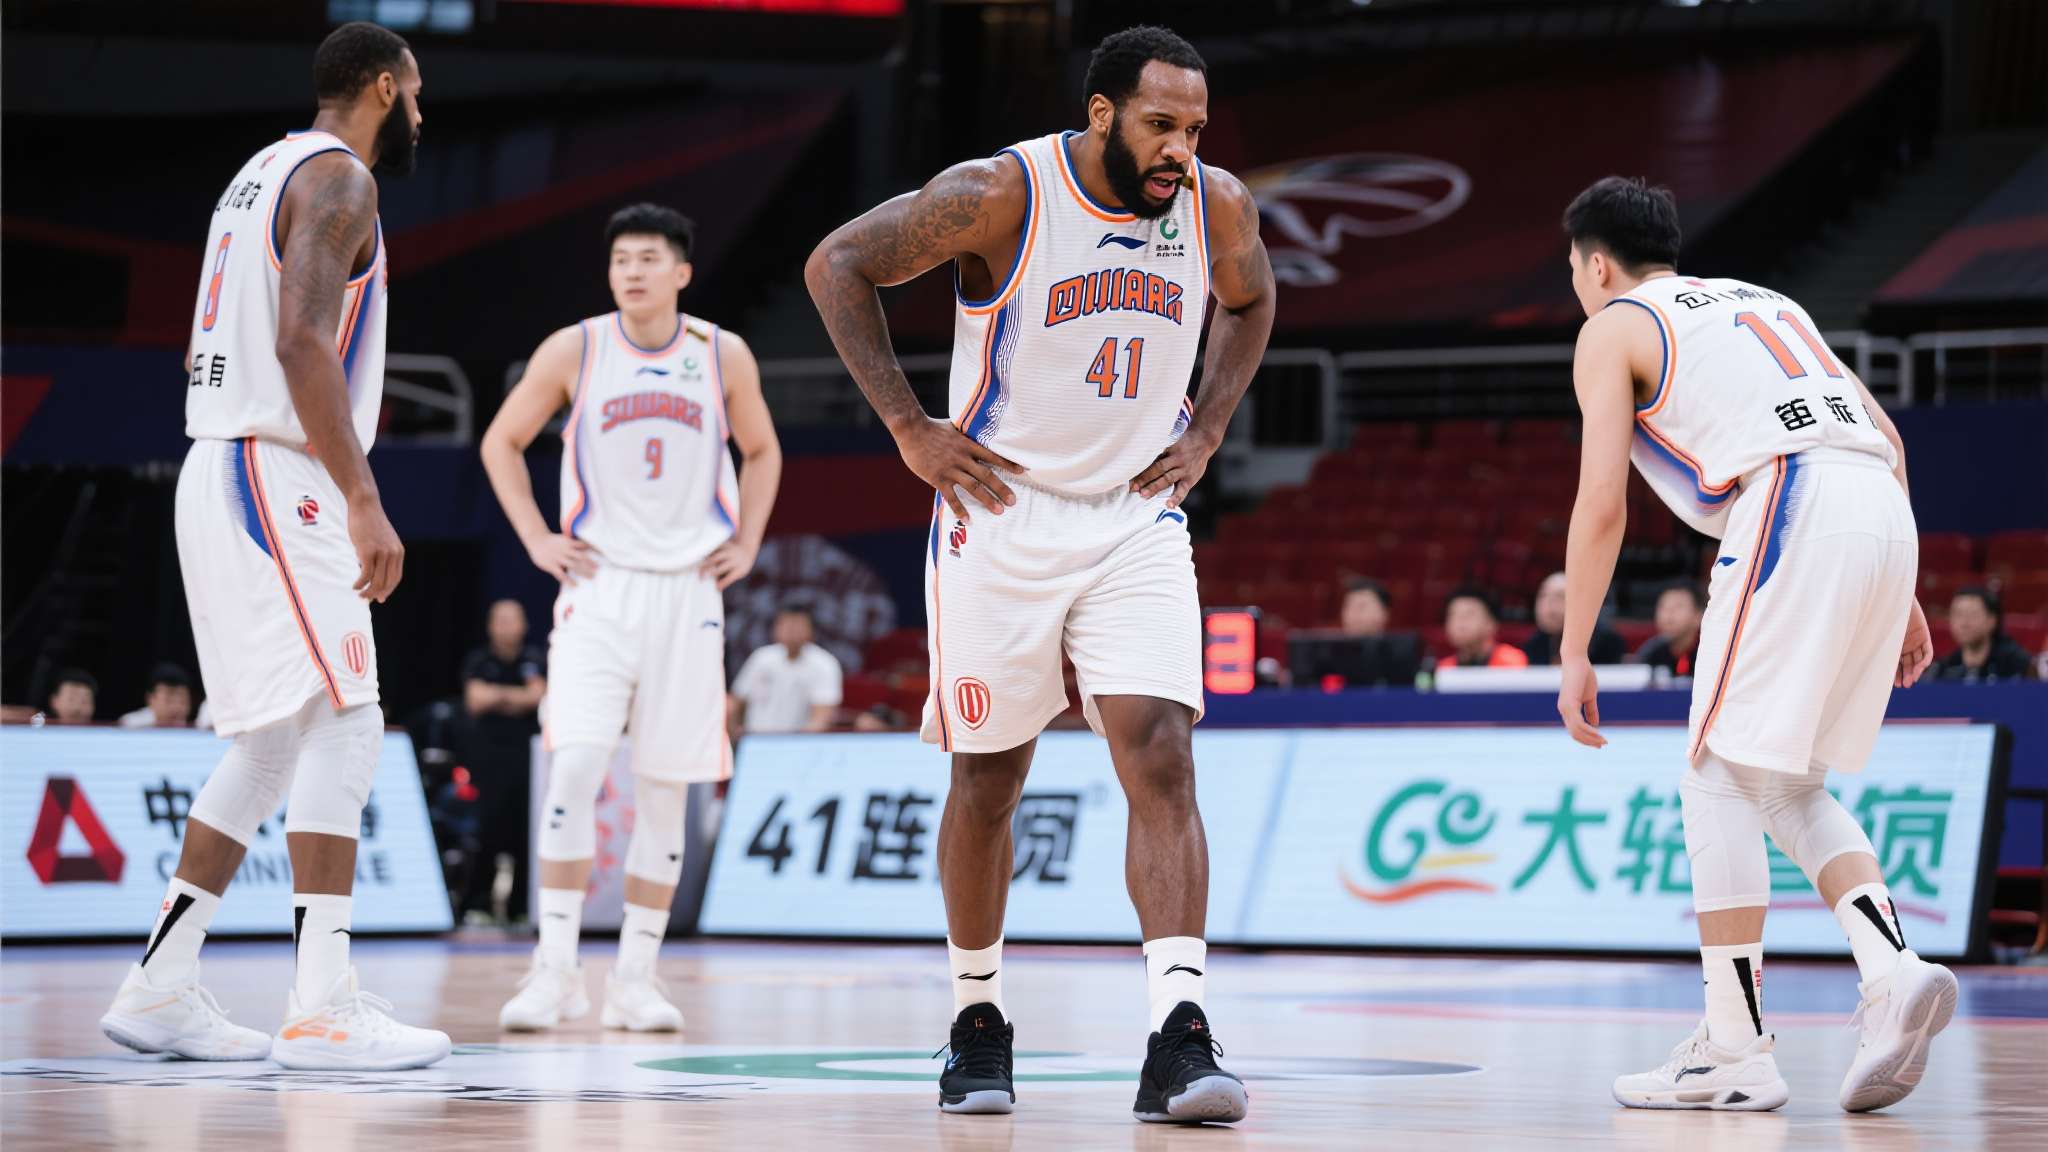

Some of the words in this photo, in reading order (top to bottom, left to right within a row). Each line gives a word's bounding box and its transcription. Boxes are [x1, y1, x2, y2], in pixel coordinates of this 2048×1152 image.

[1085, 336, 1145, 399] 41
[1734, 309, 1845, 380] 11
[645, 436, 663, 481] 9
